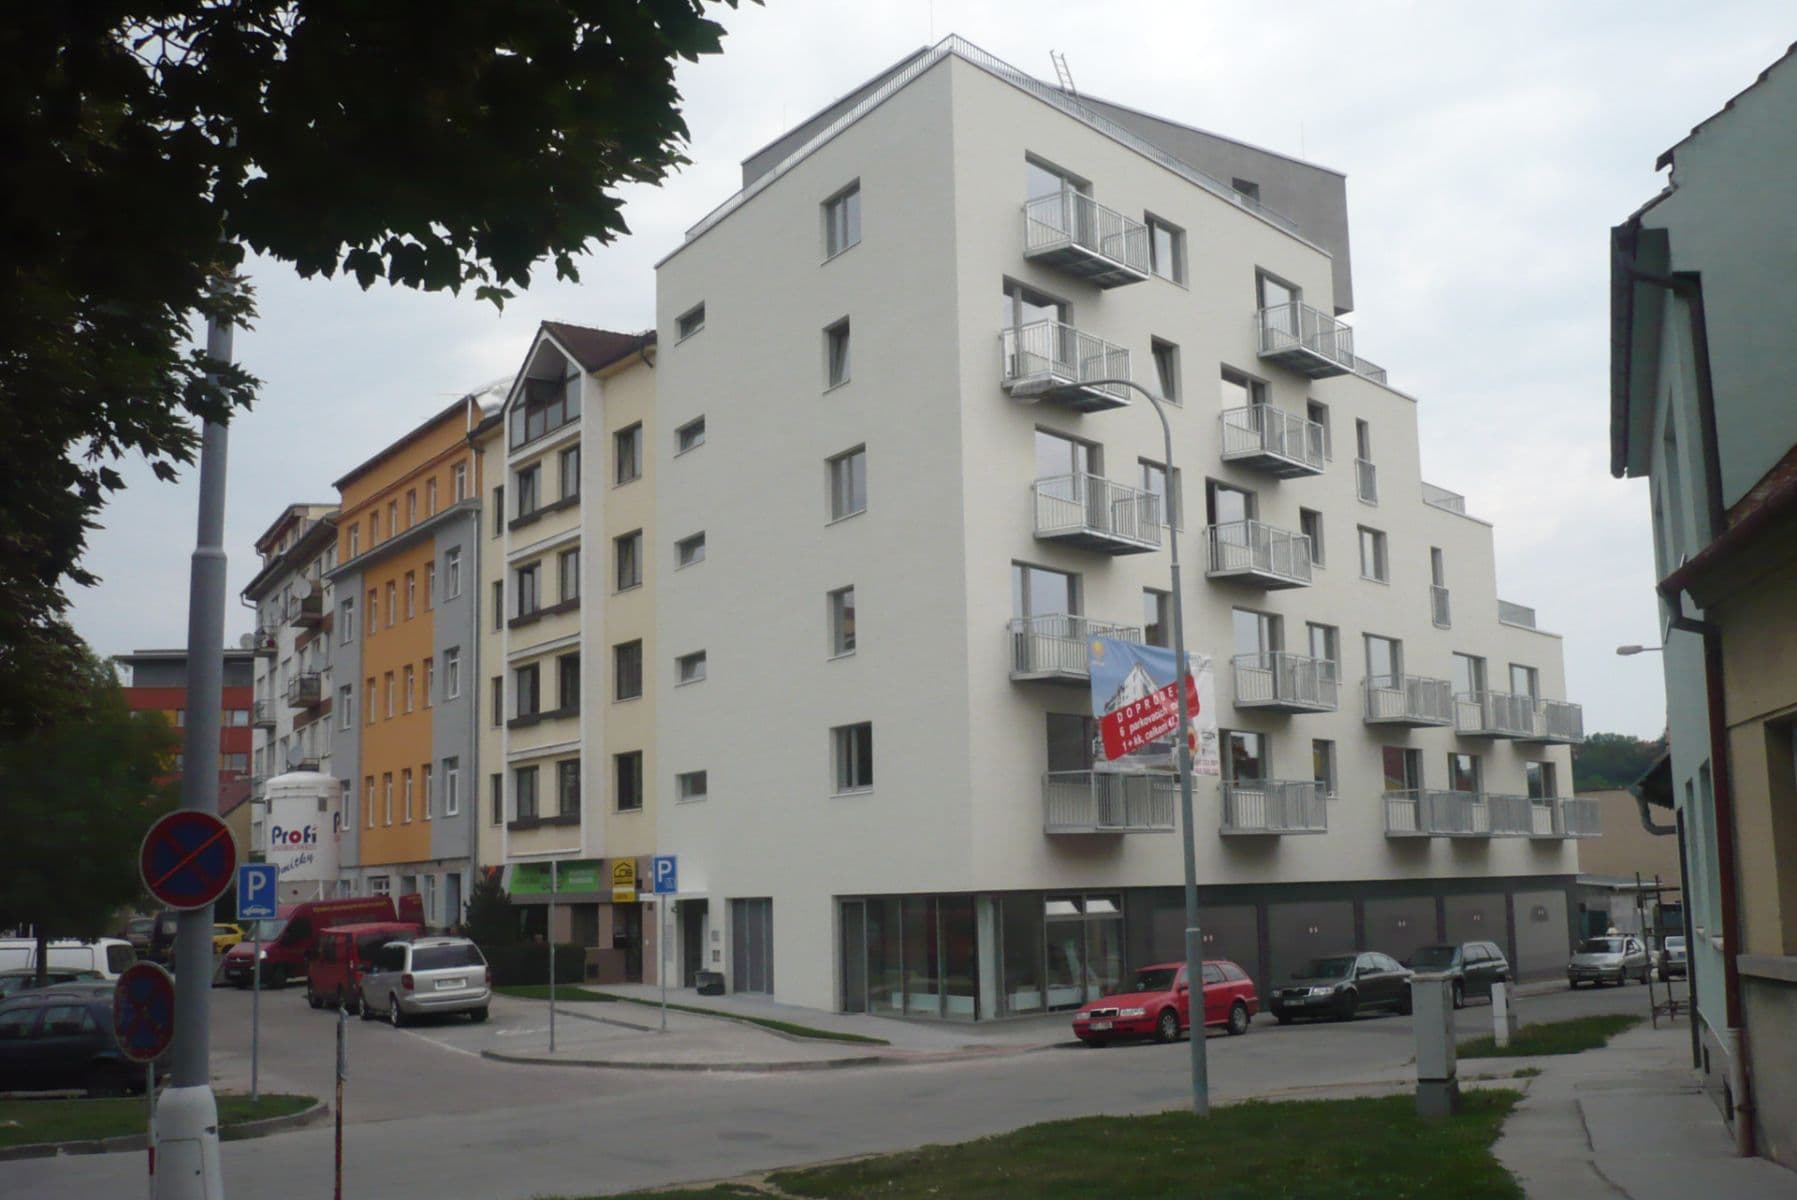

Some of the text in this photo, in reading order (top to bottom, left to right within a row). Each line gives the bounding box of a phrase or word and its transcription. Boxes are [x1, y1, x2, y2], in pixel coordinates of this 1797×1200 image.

[1116, 686, 1177, 724] DOPRODE
[272, 825, 318, 845] Profi
[658, 860, 672, 882] P
[248, 871, 266, 900] P
